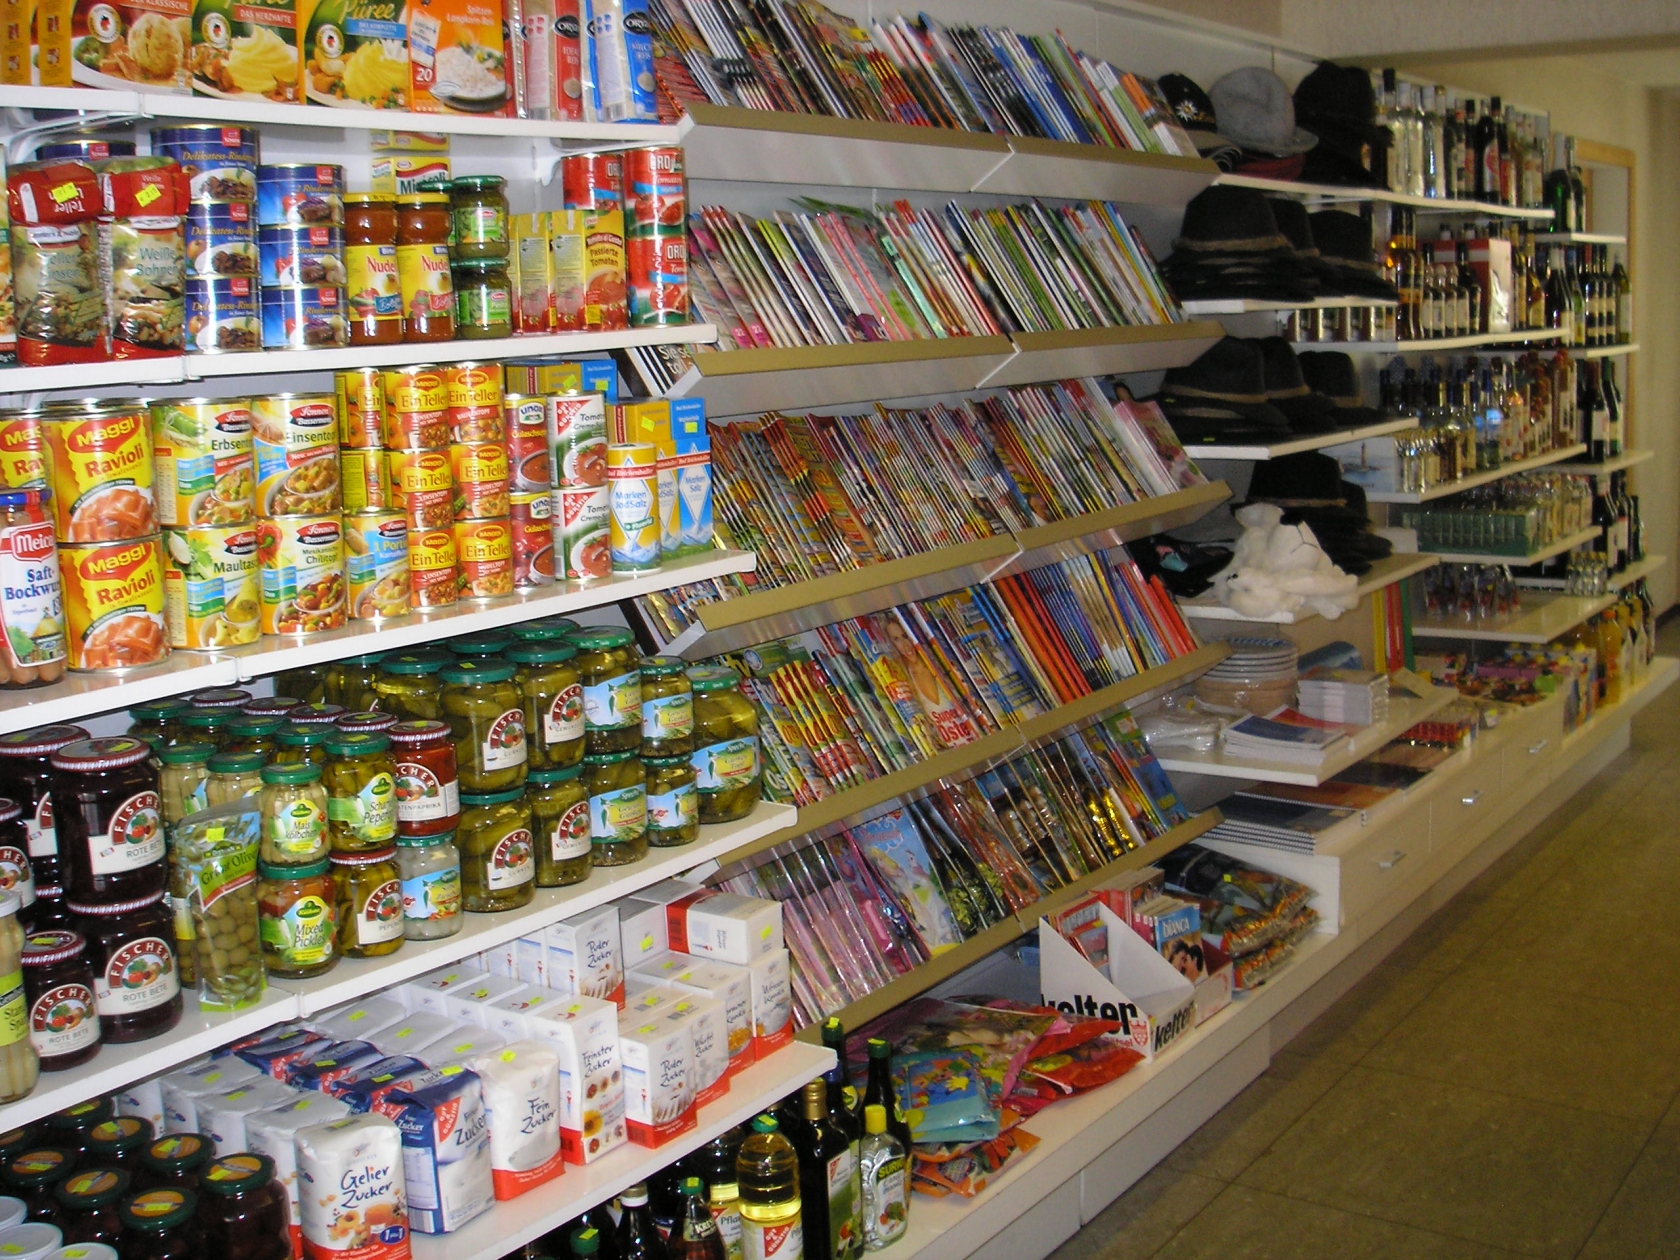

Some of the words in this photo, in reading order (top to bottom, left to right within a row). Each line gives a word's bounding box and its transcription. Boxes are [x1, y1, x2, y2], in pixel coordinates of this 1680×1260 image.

[415, 68, 433, 82] 20
[75, 417, 136, 446] Maggi
[83, 443, 146, 479] Ravioli
[614, 491, 647, 500] Marken
[614, 499, 648, 510] JodSalz
[87, 543, 147, 575] Maggi
[411, 551, 432, 566] Ein
[26, 567, 55, 585] Saft-
[95, 569, 156, 606] Ravioli
[294, 922, 324, 936] Mixed
[293, 933, 326, 947] Pickles
[586, 938, 611, 954] Puder
[587, 946, 614, 969] Zucker
[122, 990, 146, 1003] ROTE
[149, 982, 169, 997] BETE
[49, 1034, 71, 1045] ROTE
[72, 1027, 90, 1040] BETE
[582, 1043, 614, 1063] Feinster
[584, 1056, 613, 1078] Zucker
[660, 1057, 685, 1074] Puder
[660, 1066, 688, 1088] Zucker
[529, 1096, 551, 1115] Fein
[455, 1114, 486, 1146] Zucker
[520, 1109, 558, 1135] Zucker
[340, 1165, 390, 1192] Gelier
[340, 1180, 394, 1210] Zucker
